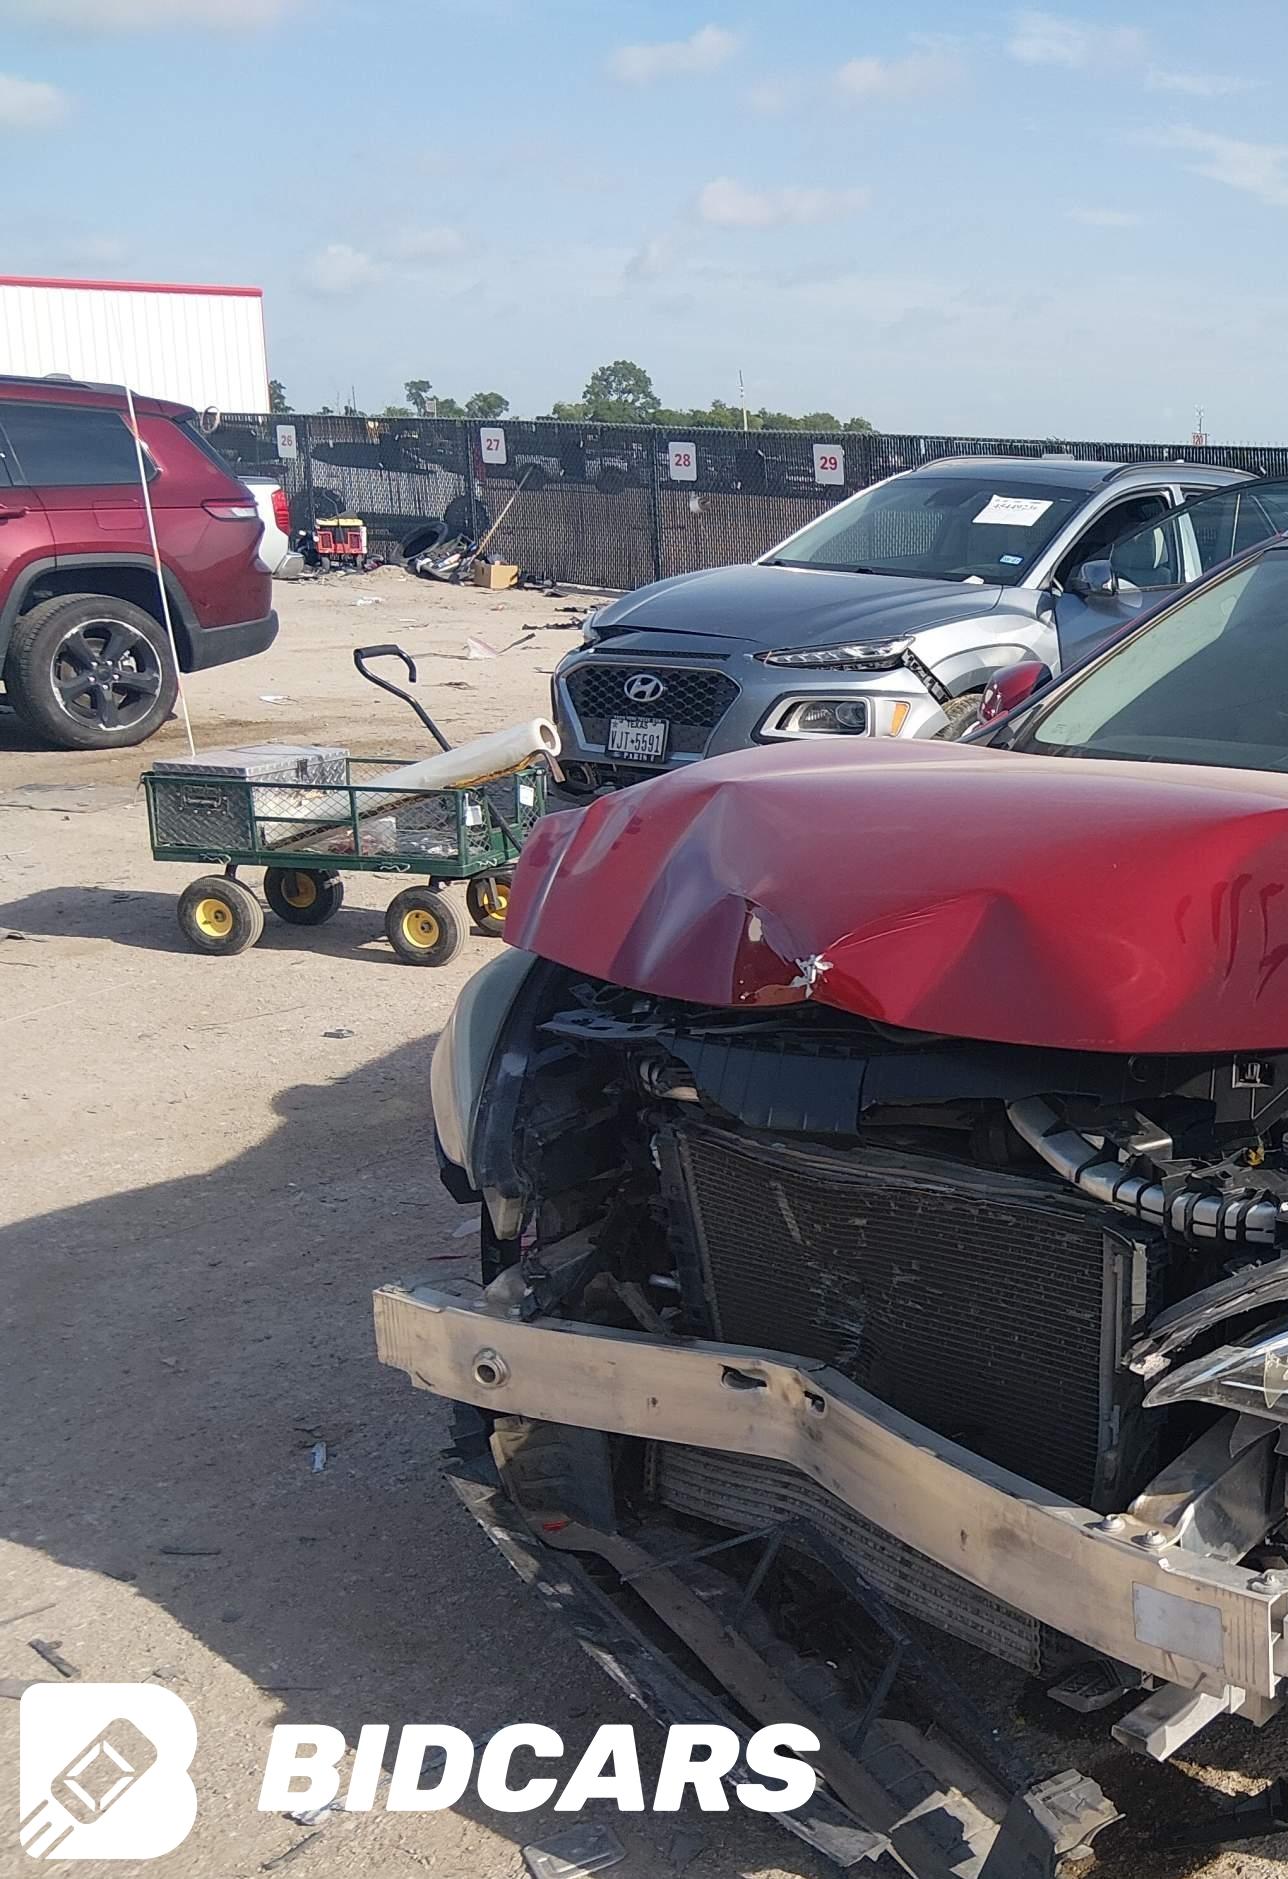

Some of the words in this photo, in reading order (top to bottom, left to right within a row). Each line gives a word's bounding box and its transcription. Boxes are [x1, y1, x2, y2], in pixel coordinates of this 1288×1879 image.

[281, 435, 292, 447] 26
[486, 439, 500, 451] 27
[674, 454, 691, 467] 28
[820, 456, 838, 470] 29
[627, 721, 648, 729] TEXAS
